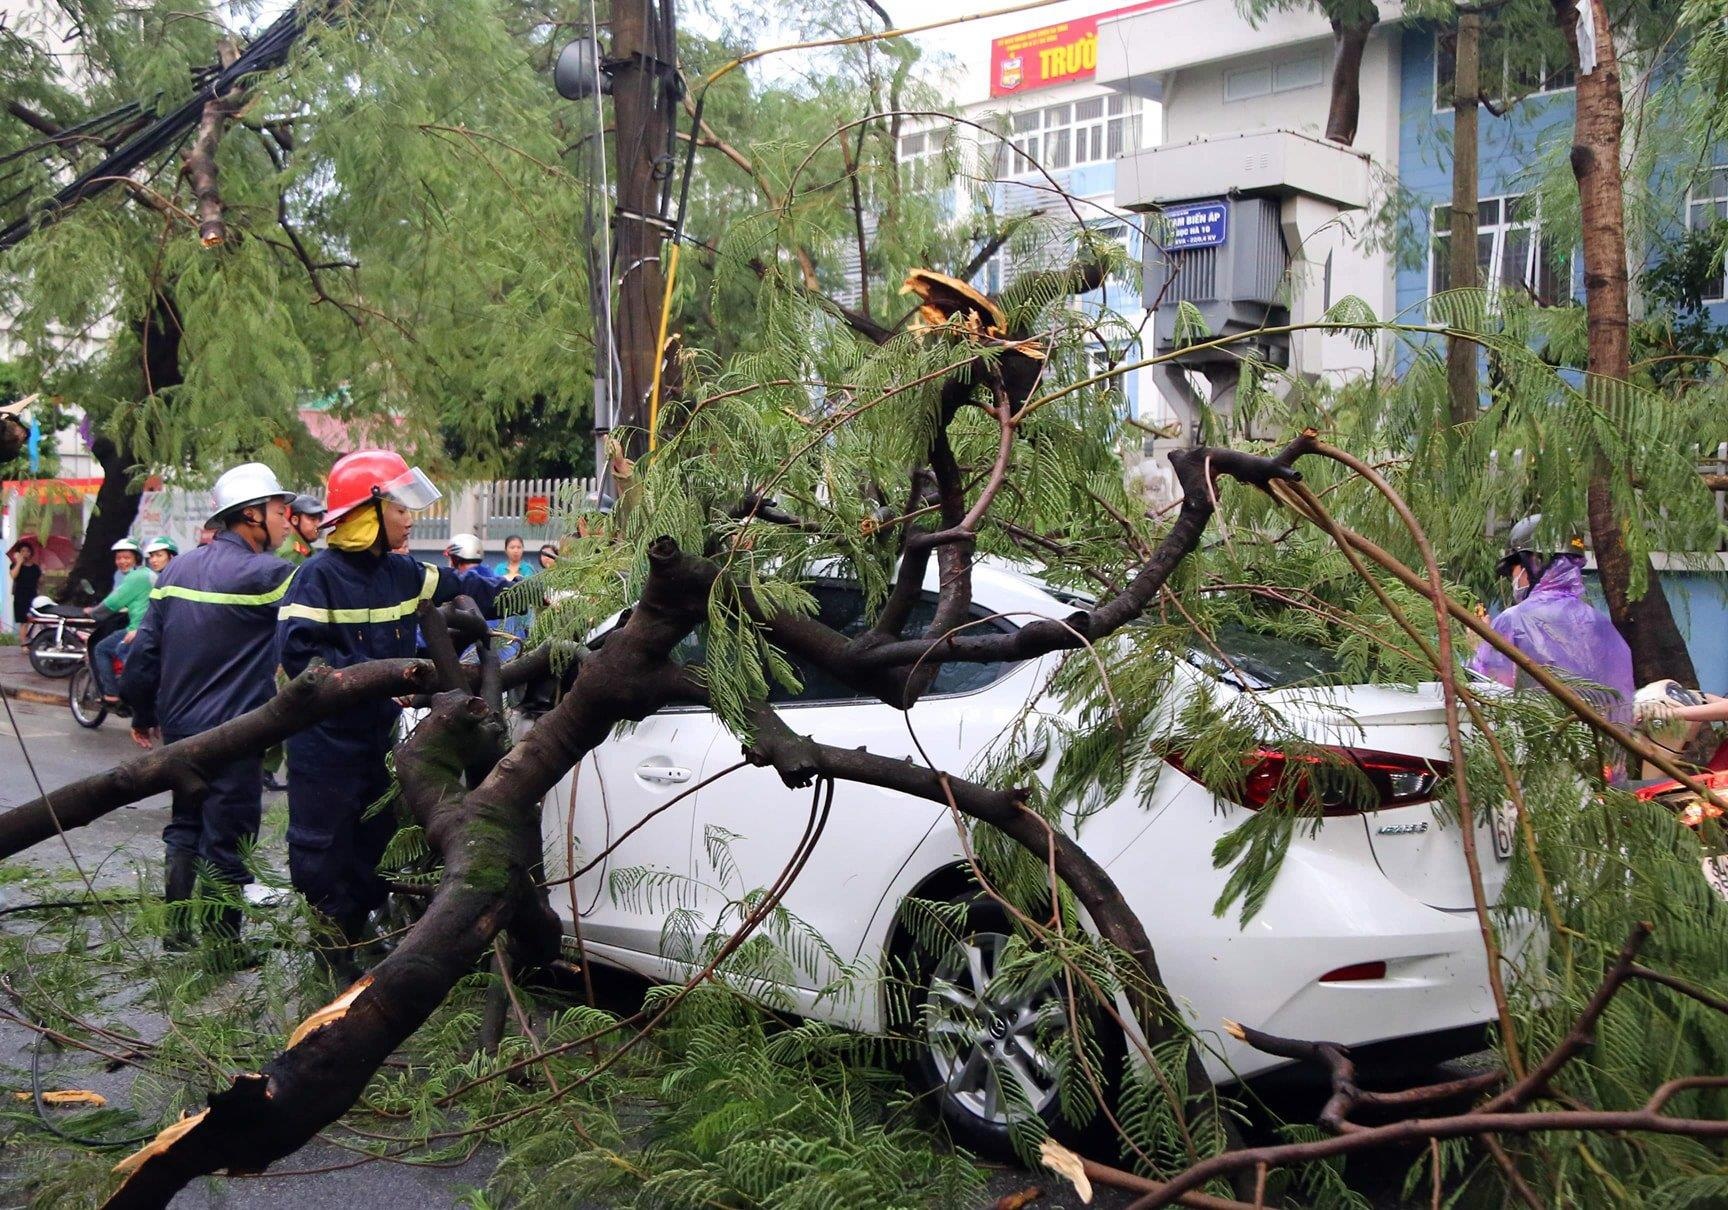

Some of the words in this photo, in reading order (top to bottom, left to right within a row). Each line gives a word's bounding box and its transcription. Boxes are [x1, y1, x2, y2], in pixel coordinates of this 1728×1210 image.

[1186, 213, 1206, 225] BIẾN
[1208, 211, 1220, 222] ÁP
[1202, 225, 1211, 234] 10
